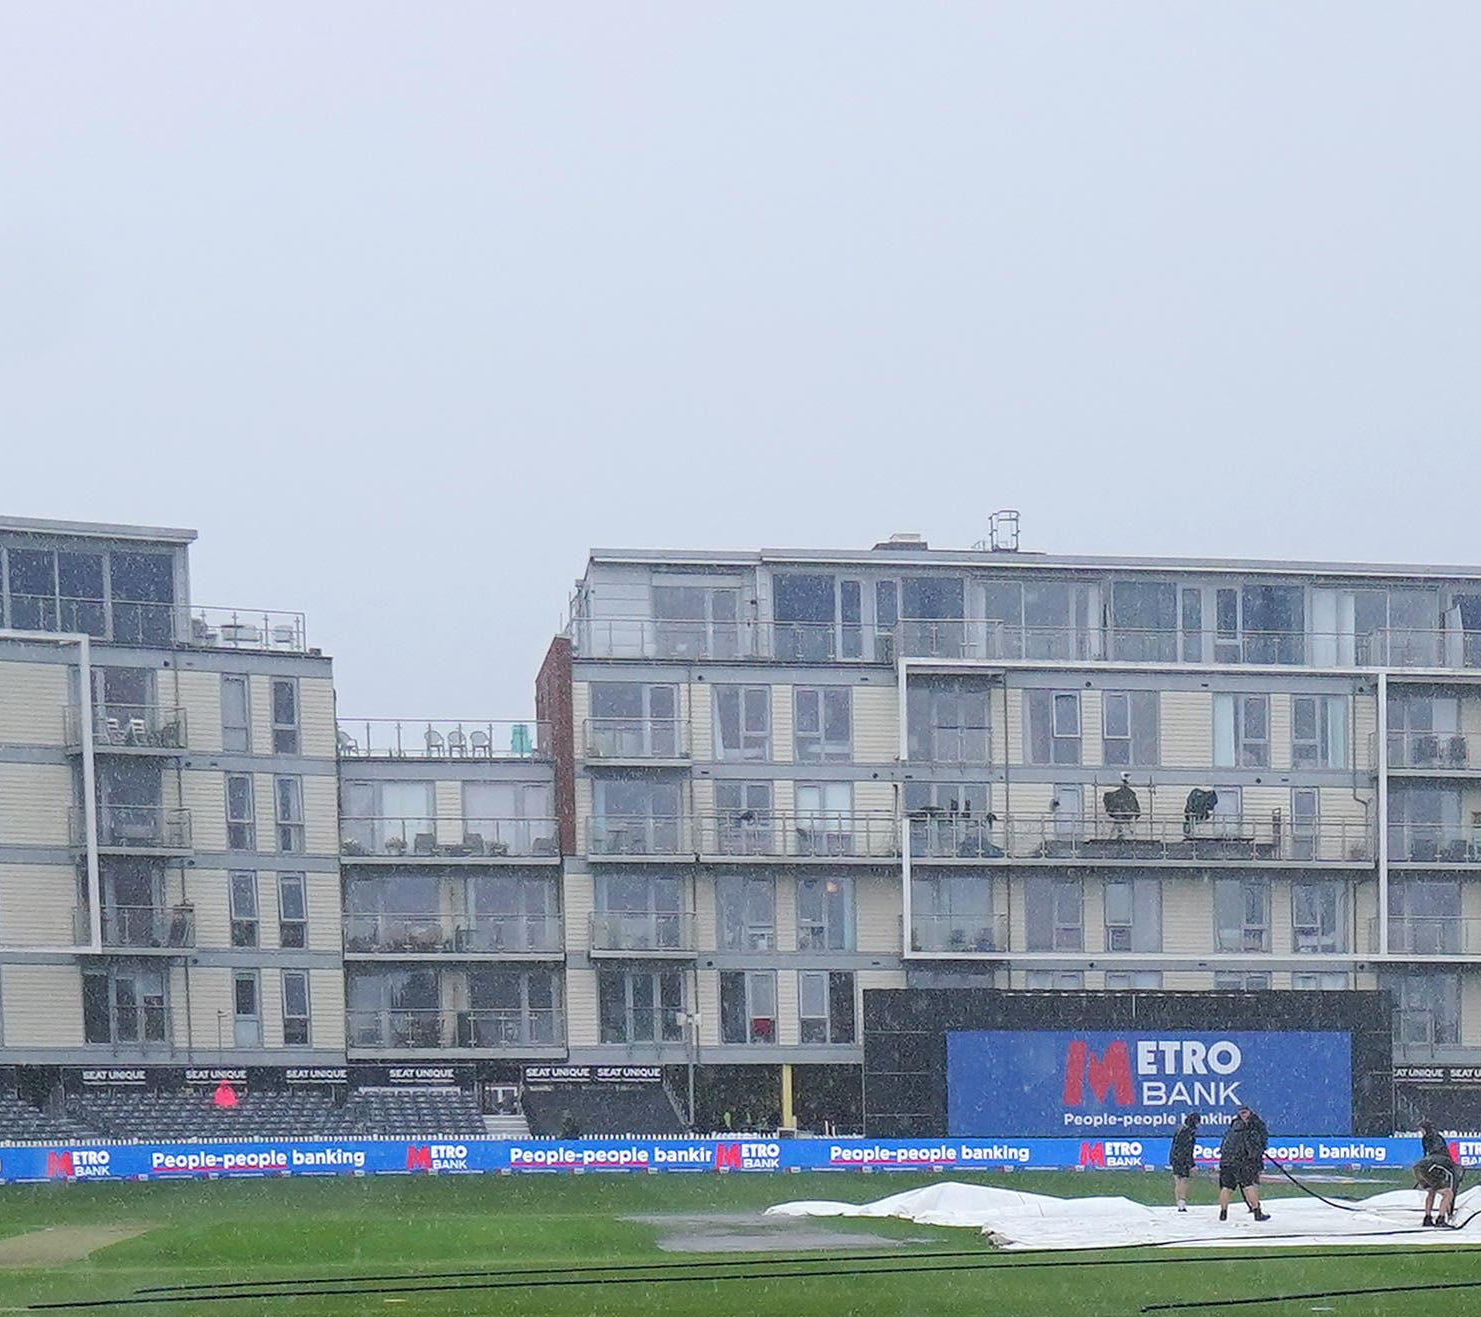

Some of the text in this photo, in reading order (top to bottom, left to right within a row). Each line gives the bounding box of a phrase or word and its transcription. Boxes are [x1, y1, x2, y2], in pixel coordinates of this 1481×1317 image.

[83, 1070, 146, 1080] SEAT UNIQUE
[186, 1070, 247, 1080] SEAT UNIQUE
[286, 1070, 347, 1079] SEAT UNIQUE
[390, 1069, 454, 1079] SEAT UNIQUE
[527, 1068, 590, 1078] SEAT UNIQUE
[598, 1068, 661, 1078] SEAT UNIQUE
[1062, 1040, 1242, 1105] METRO
[1394, 1069, 1444, 1078] EAT UNIQUE
[1450, 1069, 1474, 1078] SEAT
[1143, 1081, 1242, 1106] BANK
[1064, 1113, 1177, 1128] People-people
[406, 1144, 467, 1169] METRO
[510, 1147, 649, 1166] People-people
[716, 1144, 780, 1168] METRO
[830, 1144, 1029, 1163] People-people banking
[1080, 1141, 1142, 1167] METRO
[1320, 1144, 1385, 1161] banking
[48, 1151, 110, 1177] METRO
[152, 1149, 365, 1170] People-people banking
[433, 1158, 467, 1169] BANK
[741, 1158, 780, 1169] BANK
[1106, 1156, 1142, 1167] BANK
[74, 1166, 110, 1177] BANK
